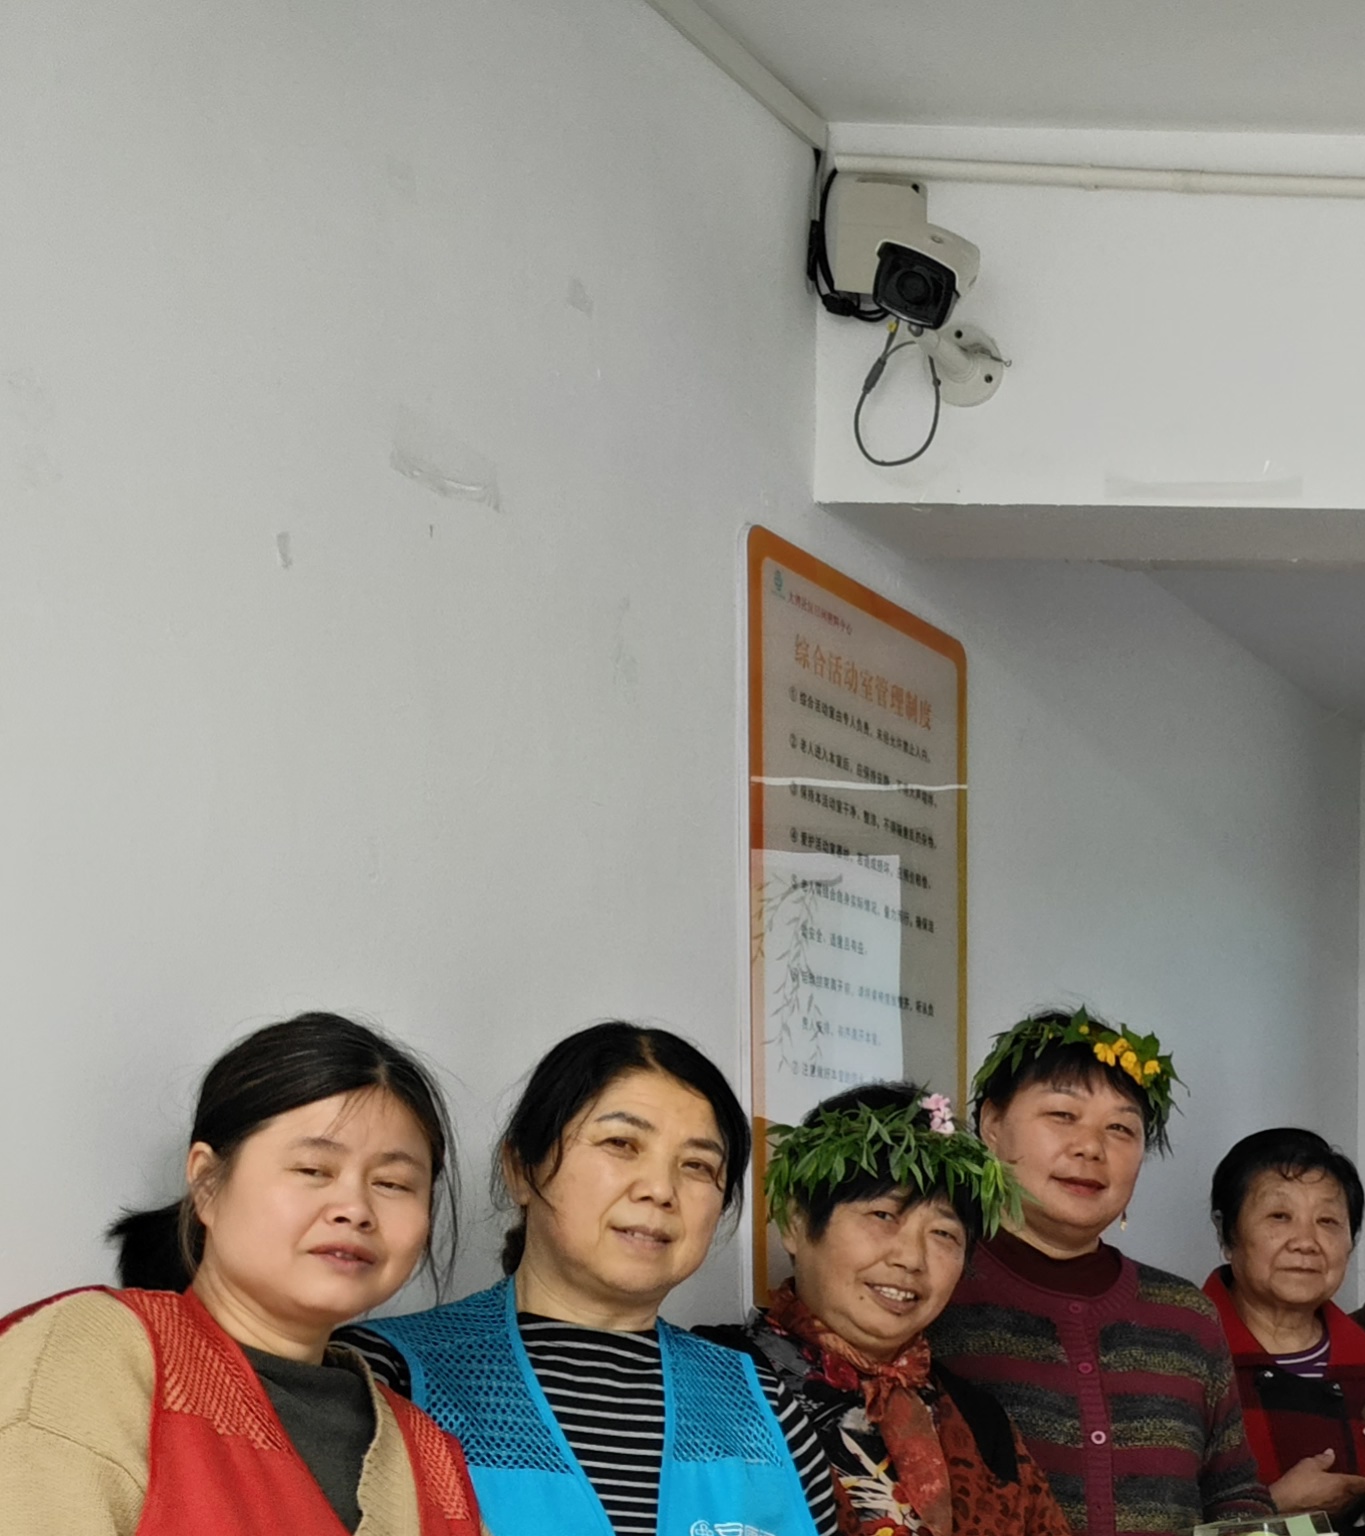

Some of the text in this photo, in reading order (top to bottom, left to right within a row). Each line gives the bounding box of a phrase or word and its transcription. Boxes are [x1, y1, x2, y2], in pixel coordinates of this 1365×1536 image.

[794, 633, 932, 731] 综合活动室管理制度
